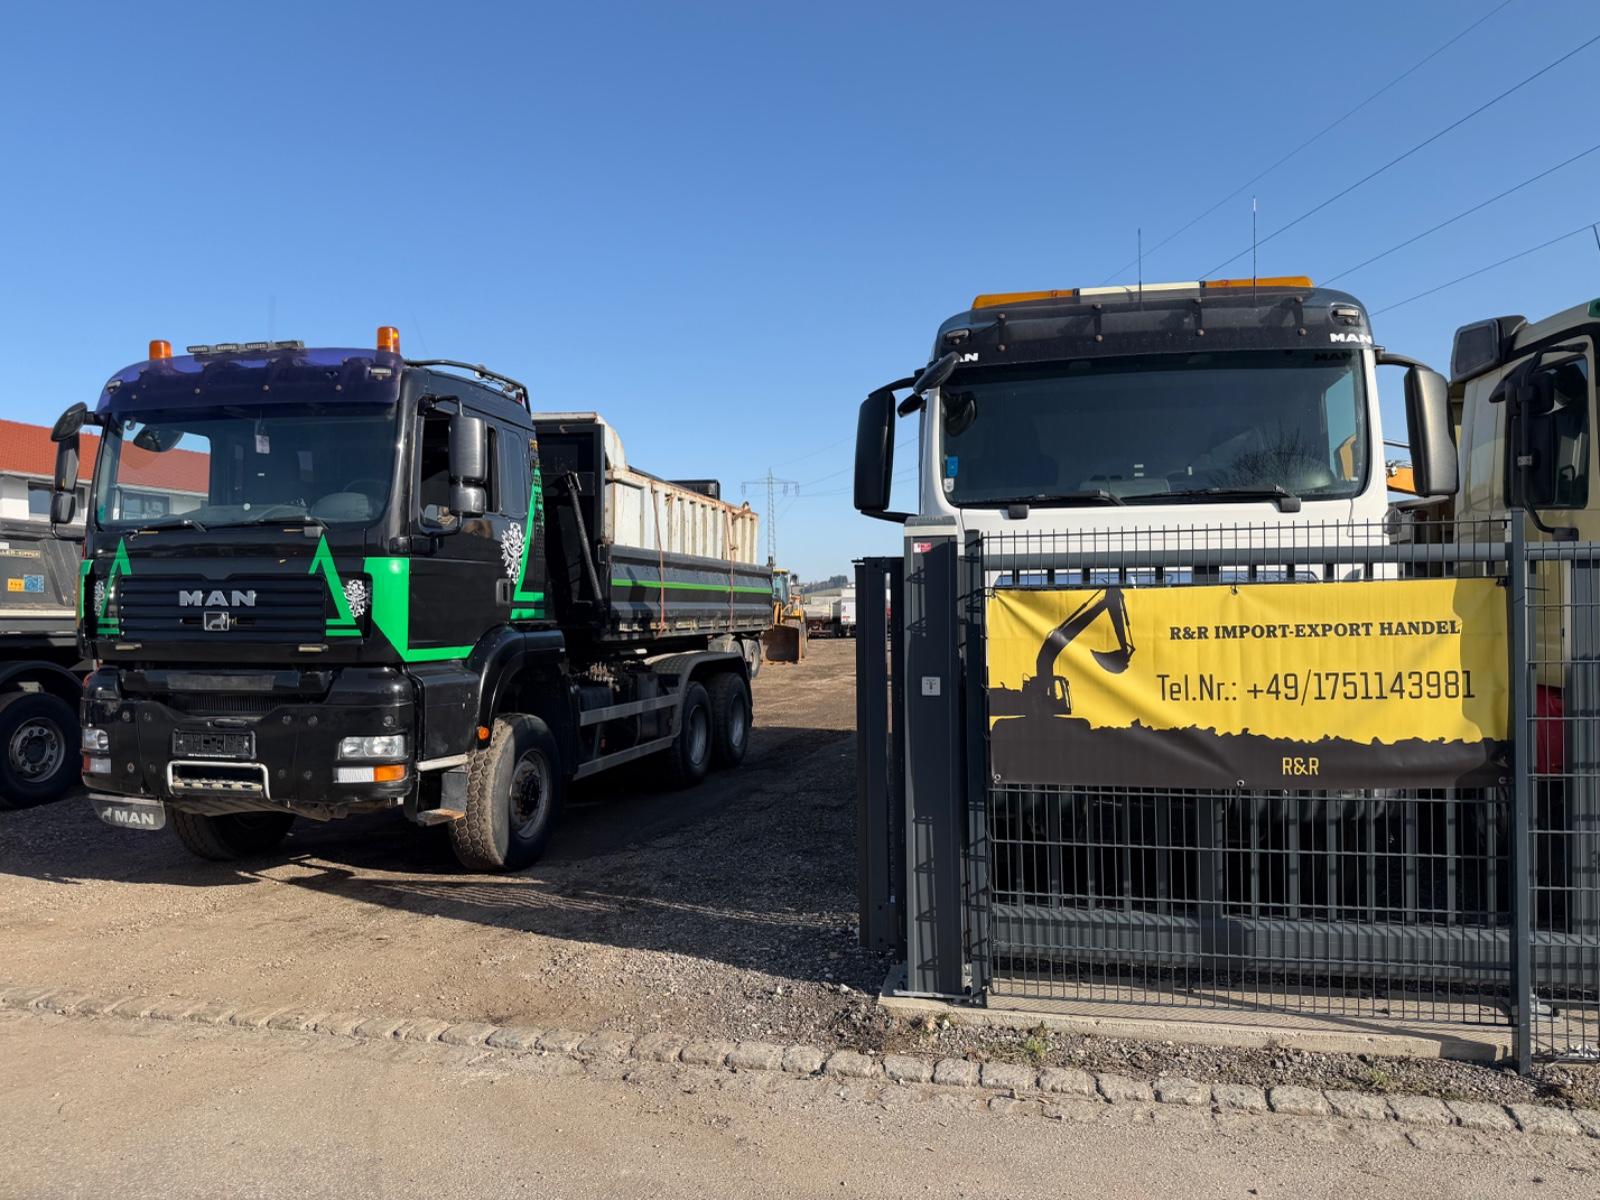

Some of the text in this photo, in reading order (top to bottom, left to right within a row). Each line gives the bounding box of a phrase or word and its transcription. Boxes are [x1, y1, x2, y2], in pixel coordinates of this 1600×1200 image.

[1329, 332, 1373, 344] MAN
[179, 590, 256, 607] MAN
[1170, 620, 1461, 640] R&R IMPORT-EXPORT HANDEL
[1156, 669, 1476, 706] Tel.Nr.: +49/1751143981
[1282, 757, 1319, 776] R&R
[114, 810, 155, 825] MAN
